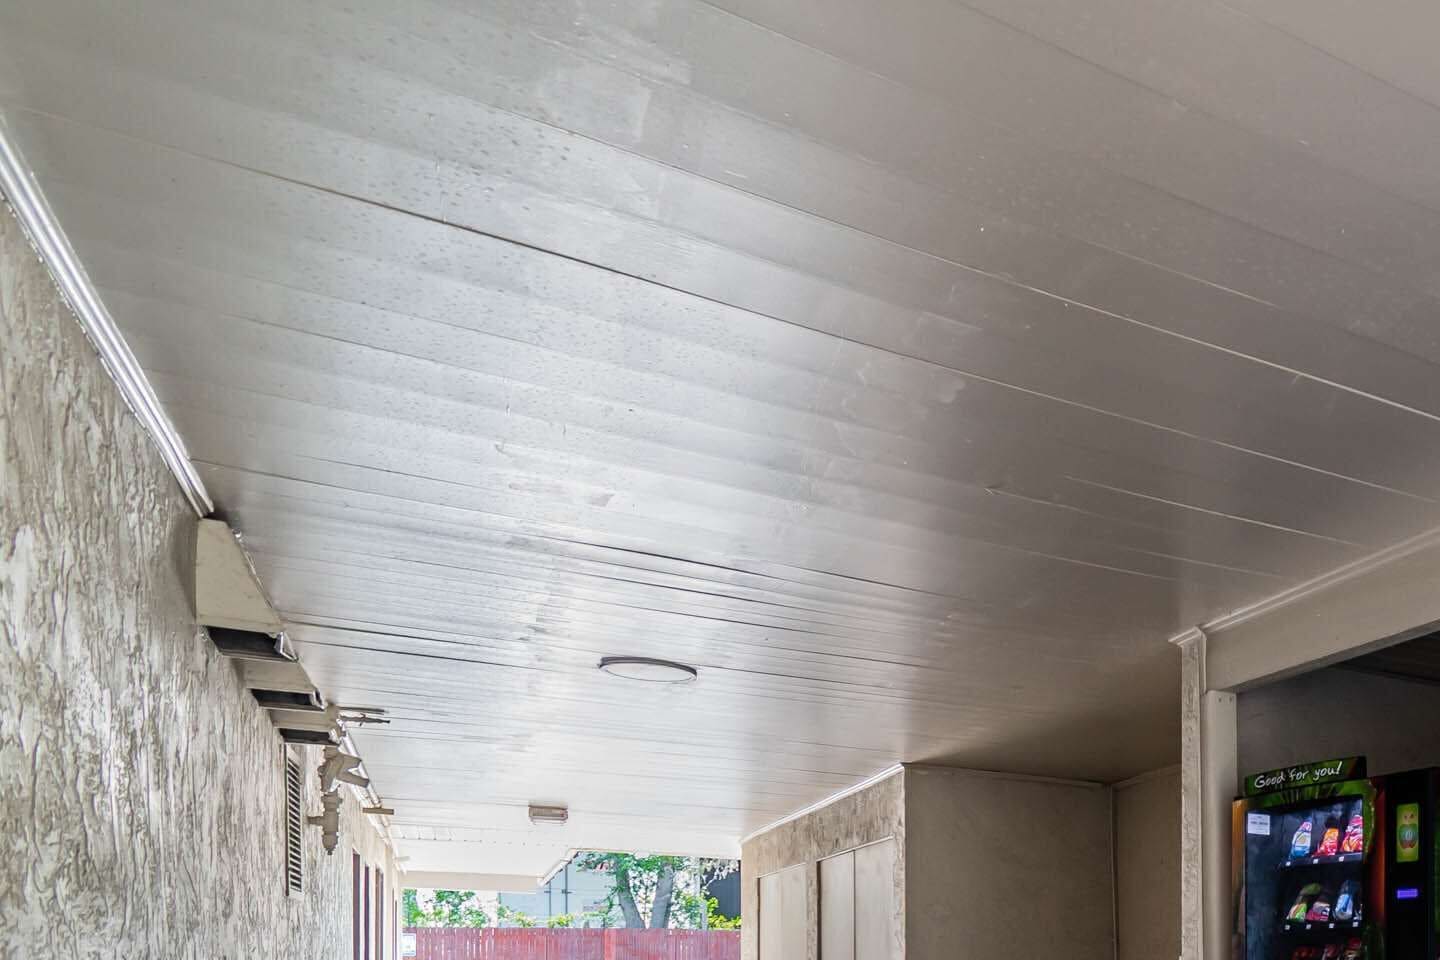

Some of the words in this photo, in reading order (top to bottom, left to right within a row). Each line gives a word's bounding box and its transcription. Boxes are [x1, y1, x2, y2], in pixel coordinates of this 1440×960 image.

[1254, 771, 1285, 788] Good
[1290, 768, 1309, 781] for
[1313, 760, 1343, 781] you!
